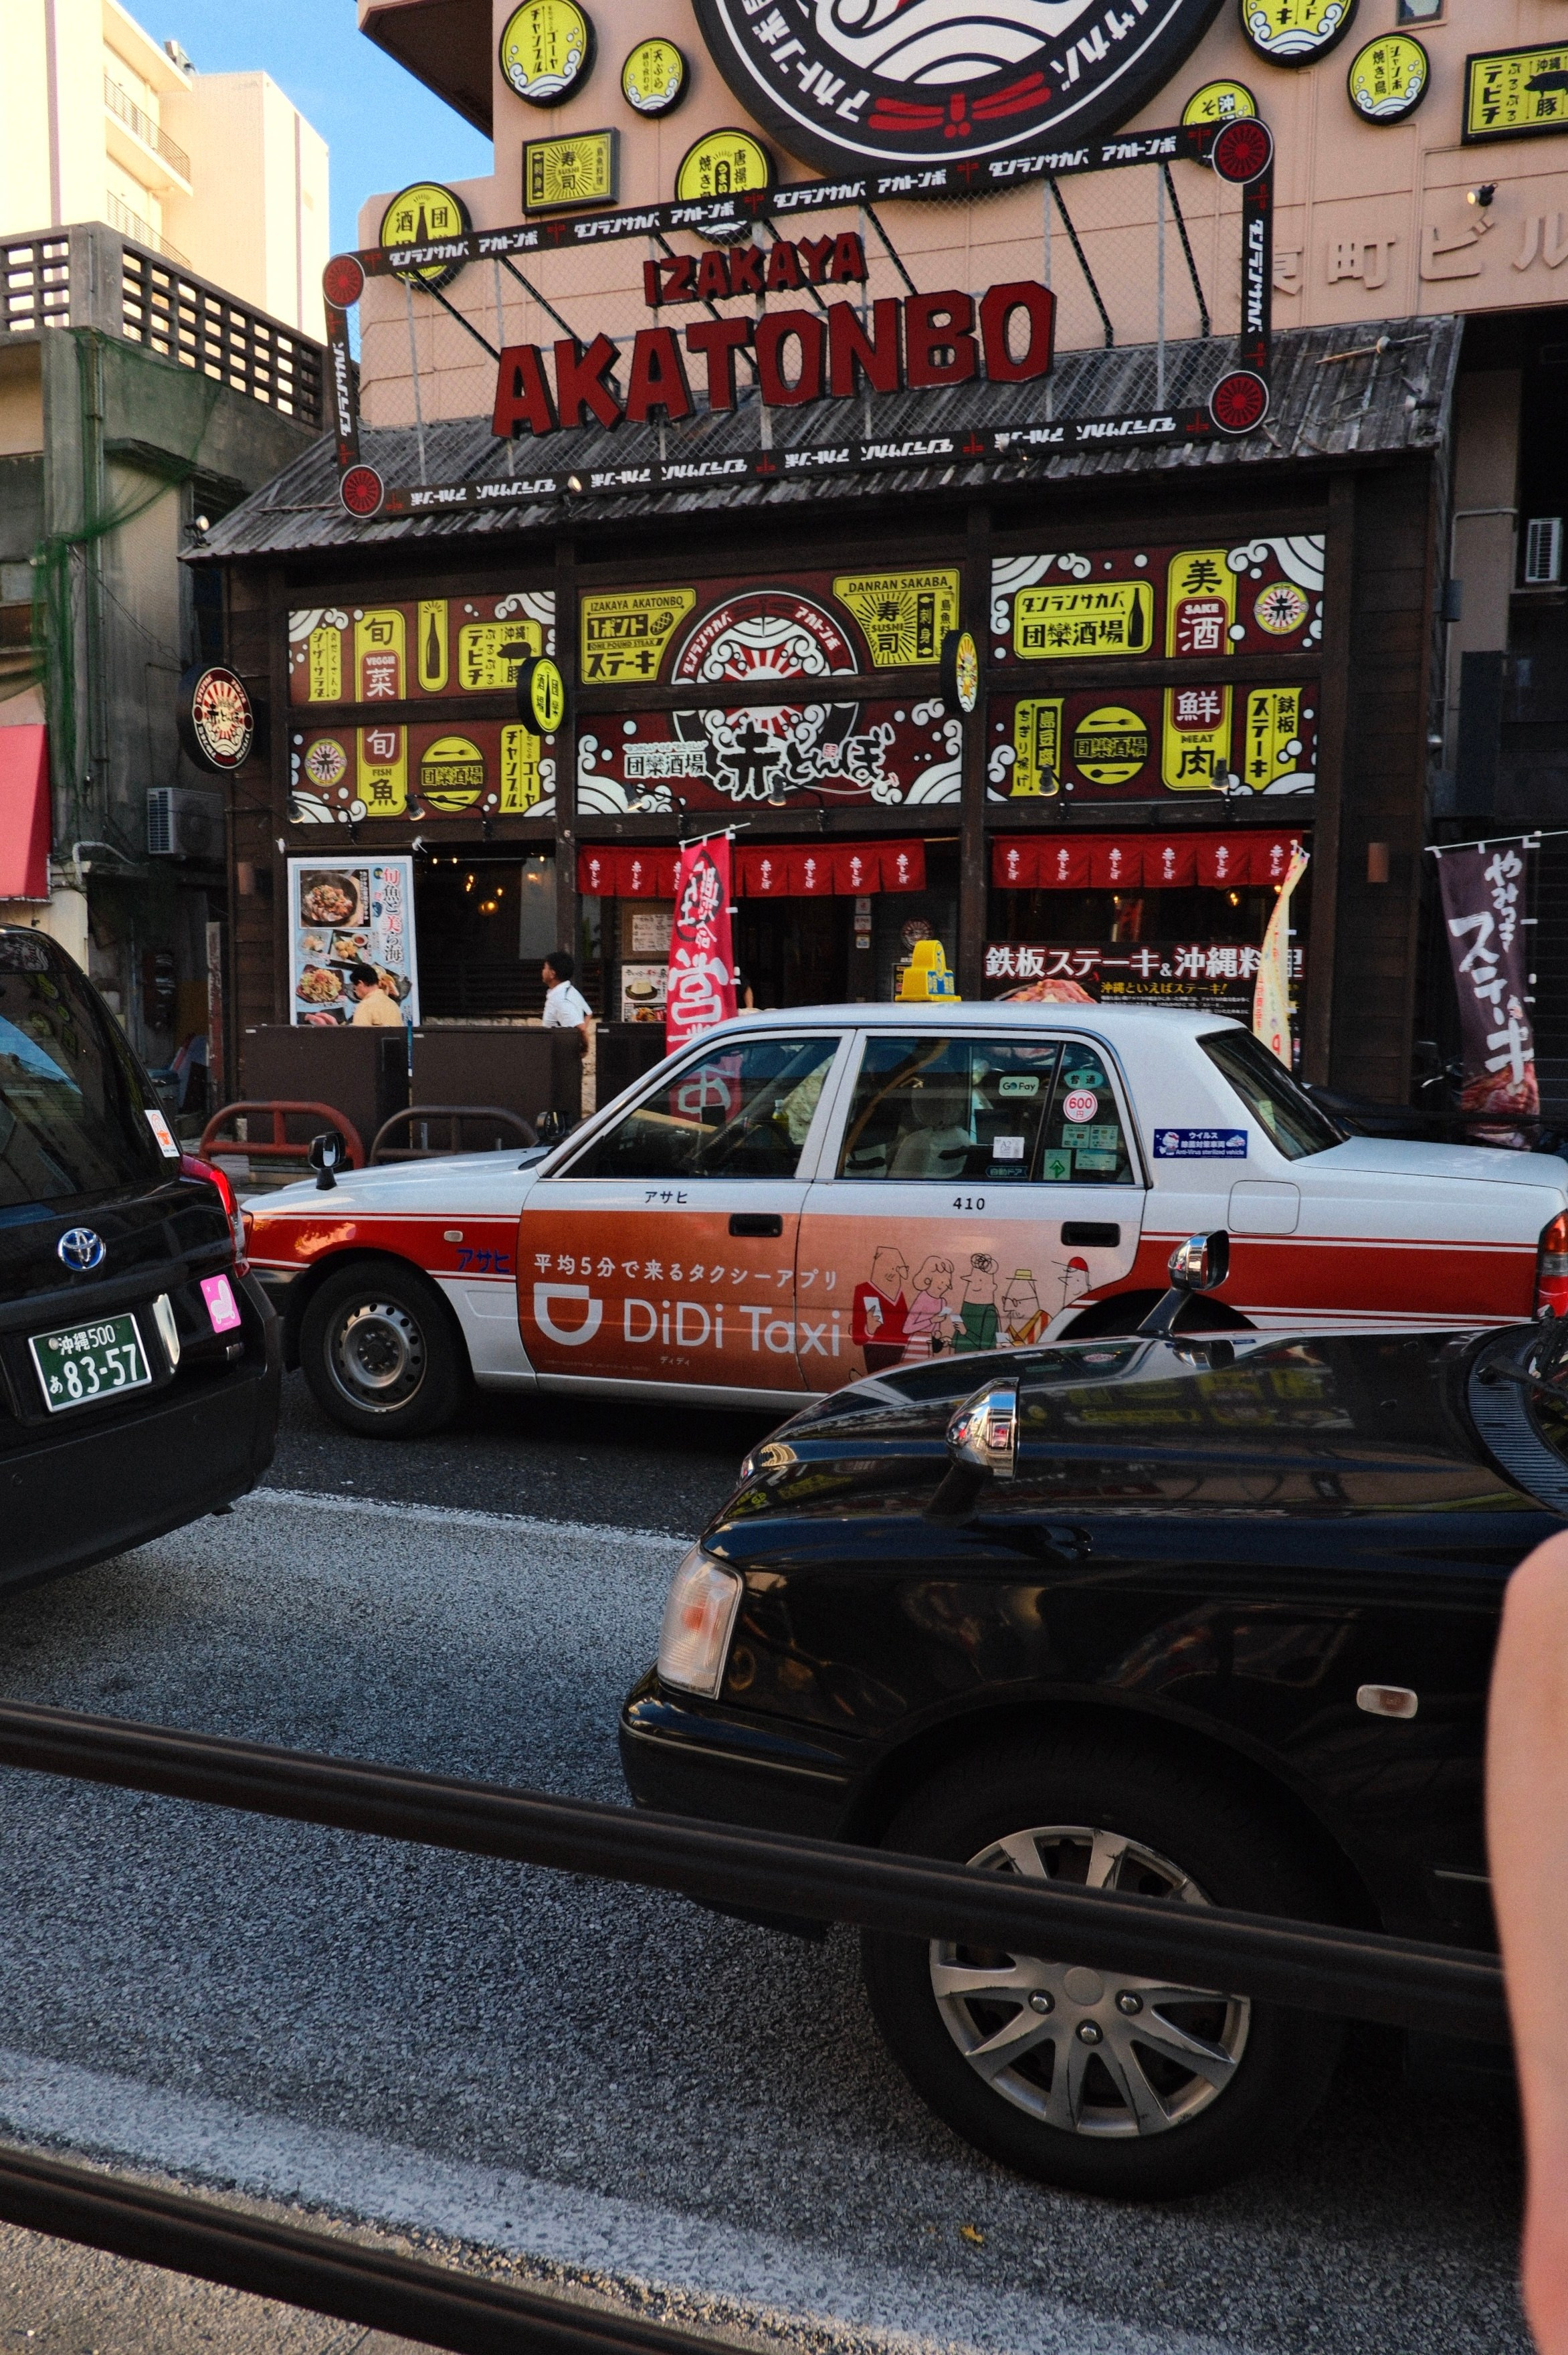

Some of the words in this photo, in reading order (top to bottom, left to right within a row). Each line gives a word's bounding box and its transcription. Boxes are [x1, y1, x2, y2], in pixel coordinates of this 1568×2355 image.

[547, 29, 559, 69] ゴーヤ
[653, 49, 664, 89] 天ぷら
[1373, 50, 1387, 95] 焼き鳥
[1536, 56, 1561, 72] 沖縄
[1482, 65, 1502, 124] テビチ
[1536, 97, 1557, 117] 豚
[699, 155, 712, 197] 焼き
[734, 149, 747, 193] 唐揚
[642, 231, 871, 308] IZAKAYA
[491, 278, 1058, 440] AKATONBO
[849, 579, 898, 593] DANRAN
[901, 575, 948, 589] SAKABA
[1181, 558, 1223, 594] 美
[591, 599, 629, 611] IZAKAYA
[632, 595, 684, 609] AKATONBO
[877, 600, 900, 622] 寿
[1184, 603, 1219, 615] SAKE
[364, 618, 393, 646] 旬
[590, 616, 645, 638] 1ポンド
[871, 623, 904, 633] SUSHI
[919, 607, 933, 644] 刺身
[1177, 617, 1224, 652] 酒
[468, 629, 484, 686] テビチ
[877, 633, 899, 654] 司
[366, 656, 396, 666] VEGGIE
[587, 650, 656, 678] ステーキ
[366, 668, 396, 697] 菜
[1176, 690, 1221, 723] 鮮
[1276, 695, 1296, 734] 鉄板
[367, 729, 396, 759] 旬
[1181, 734, 1214, 744] MEAT
[1250, 697, 1269, 778] ステーキ
[372, 769, 392, 777] FISH
[1176, 745, 1215, 779] 肉
[369, 778, 398, 807] 魚
[523, 761, 537, 806] ゴーヤ
[1484, 850, 1523, 953] やみつき
[1448, 911, 1535, 1091] ステーキ
[1019, 1082, 1036, 1091] Pay
[1071, 1074, 1096, 1085] 普通
[1070, 1097, 1092, 1109] 600
[1076, 1110, 1084, 1118] 円
[644, 1191, 688, 1204] アサヒ
[953, 1198, 985, 1210] 410
[456, 1248, 510, 1274] アサヒ
[534, 1253, 837, 1291] 平均5分で来るタクシーアプリ
[623, 1297, 723, 1349] DiDi
[739, 1305, 840, 1357] Taxi
[50, 1374, 64, 1394] あ
[64, 1343, 138, 1399] 83-57
[660, 1356, 690, 1367] ディディ
